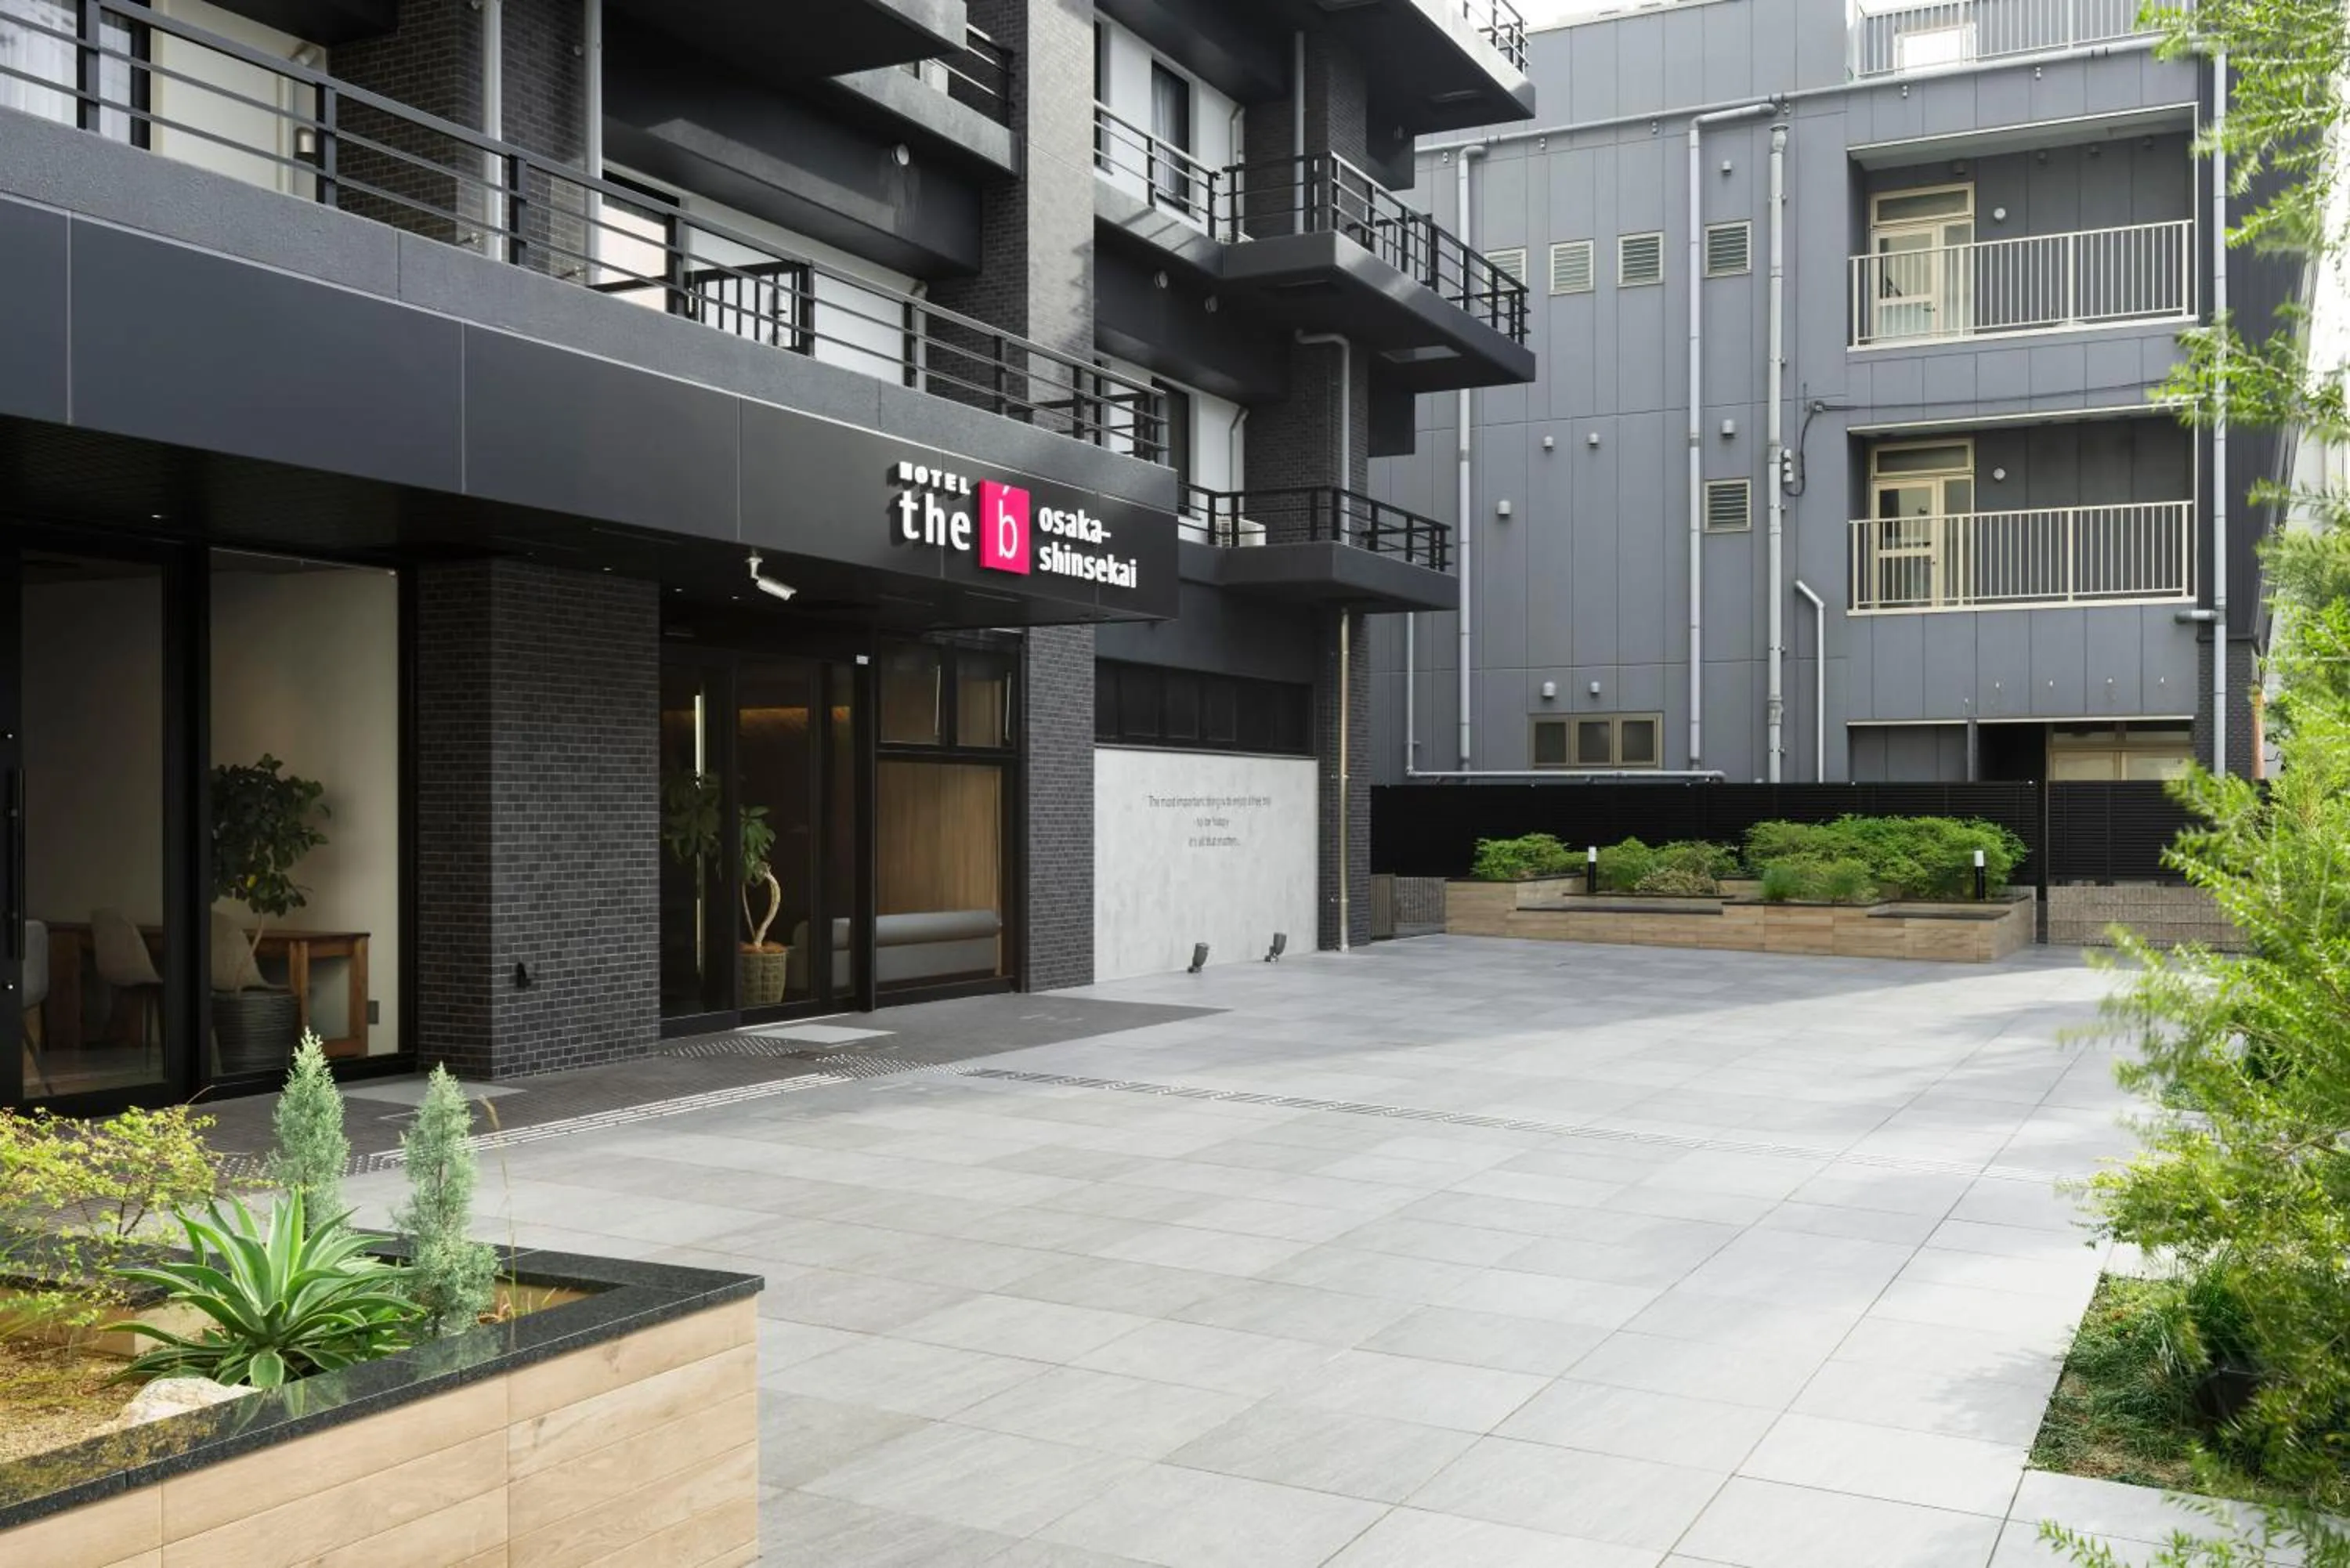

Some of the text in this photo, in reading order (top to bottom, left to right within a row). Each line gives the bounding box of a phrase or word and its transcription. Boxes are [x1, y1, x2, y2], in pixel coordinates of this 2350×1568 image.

[899, 461, 971, 495] HOTEL
[899, 490, 971, 551] the
[1039, 507, 1112, 544] osaka-
[1039, 542, 1137, 588] shinsekai
